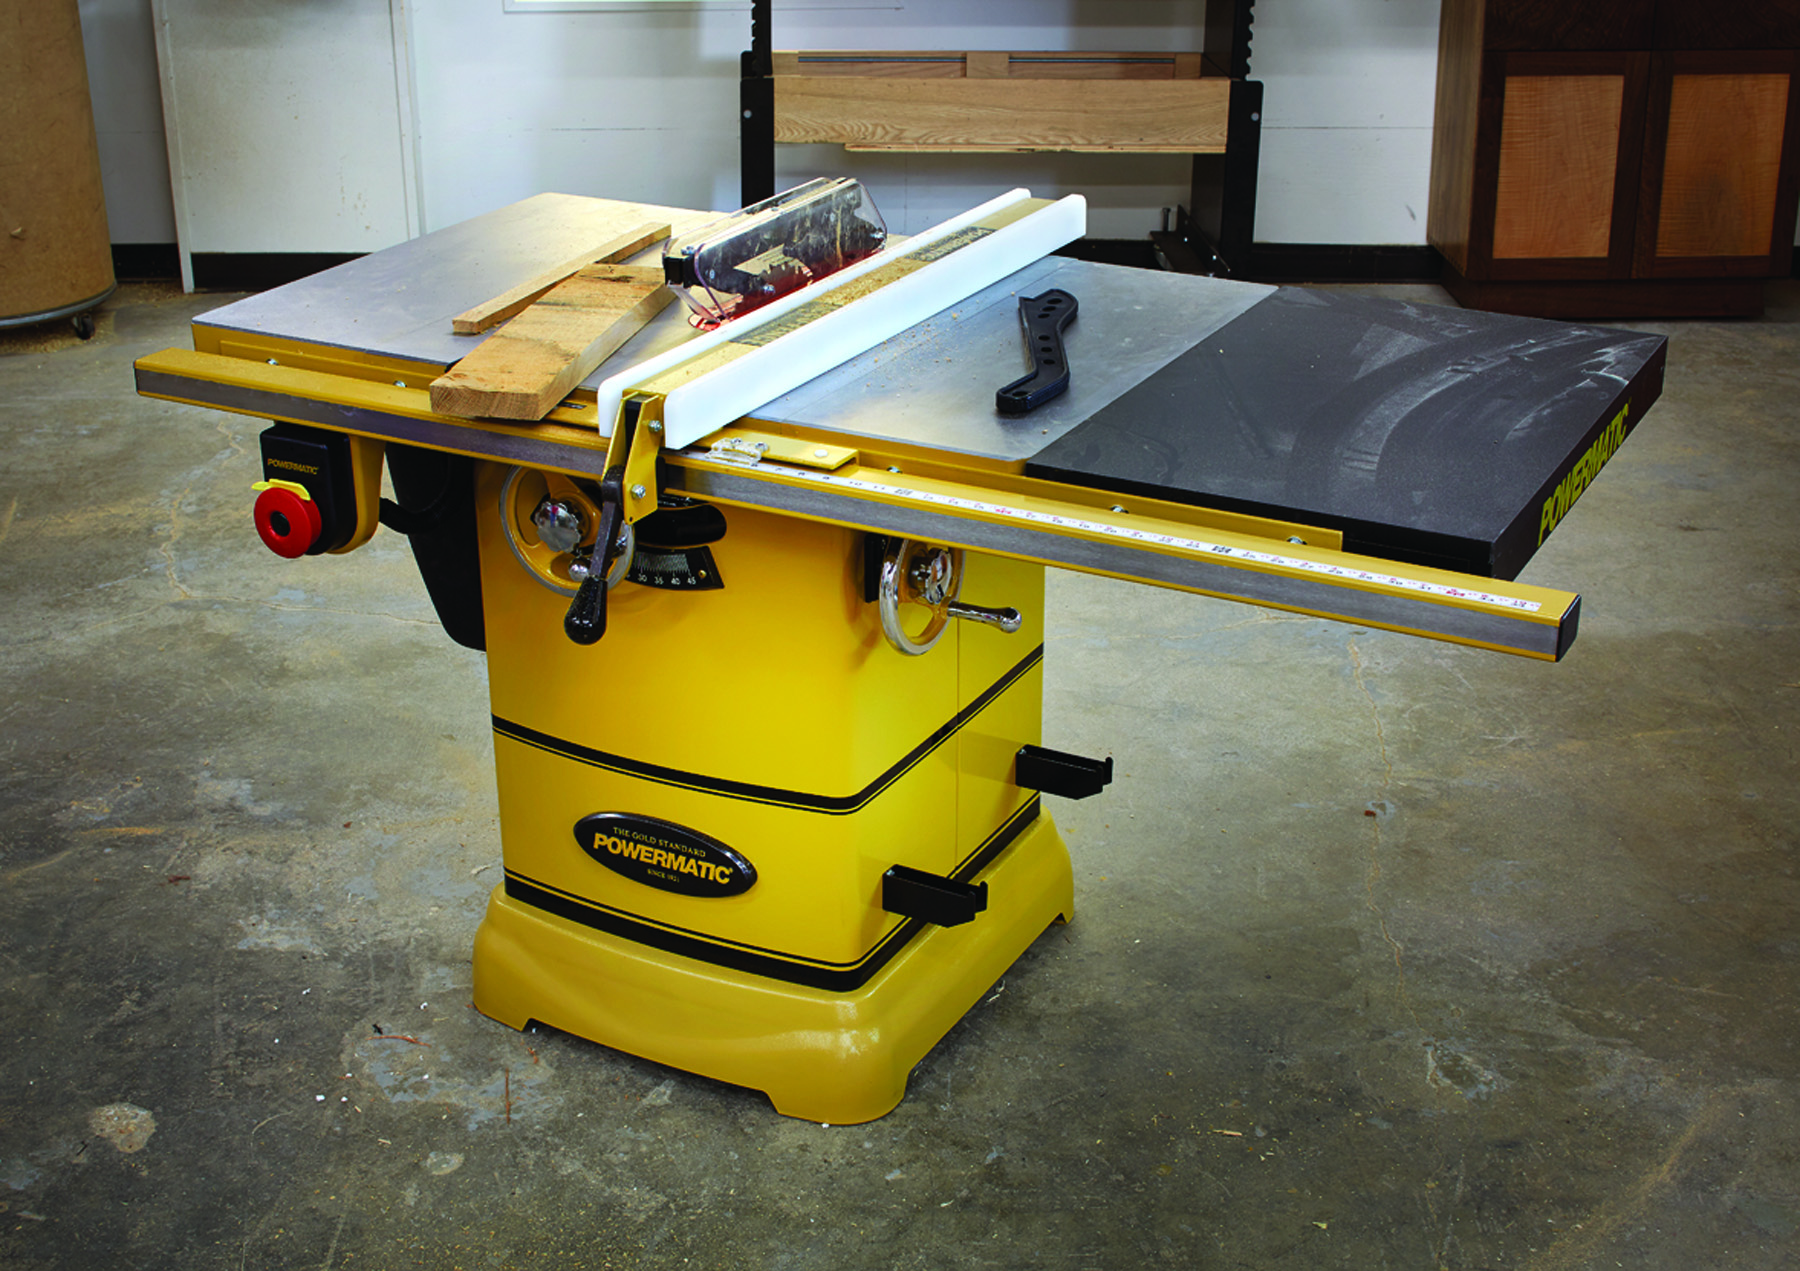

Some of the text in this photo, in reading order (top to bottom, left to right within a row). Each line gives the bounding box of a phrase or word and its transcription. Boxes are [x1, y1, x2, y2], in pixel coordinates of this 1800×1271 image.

[268, 458, 319, 475] POWERMATIC
[1537, 403, 1630, 547] POWERMATIC
[687, 576, 697, 585] 45
[614, 827, 706, 857] THE GOLD STANDARD
[593, 833, 731, 884] POWERMATIC
